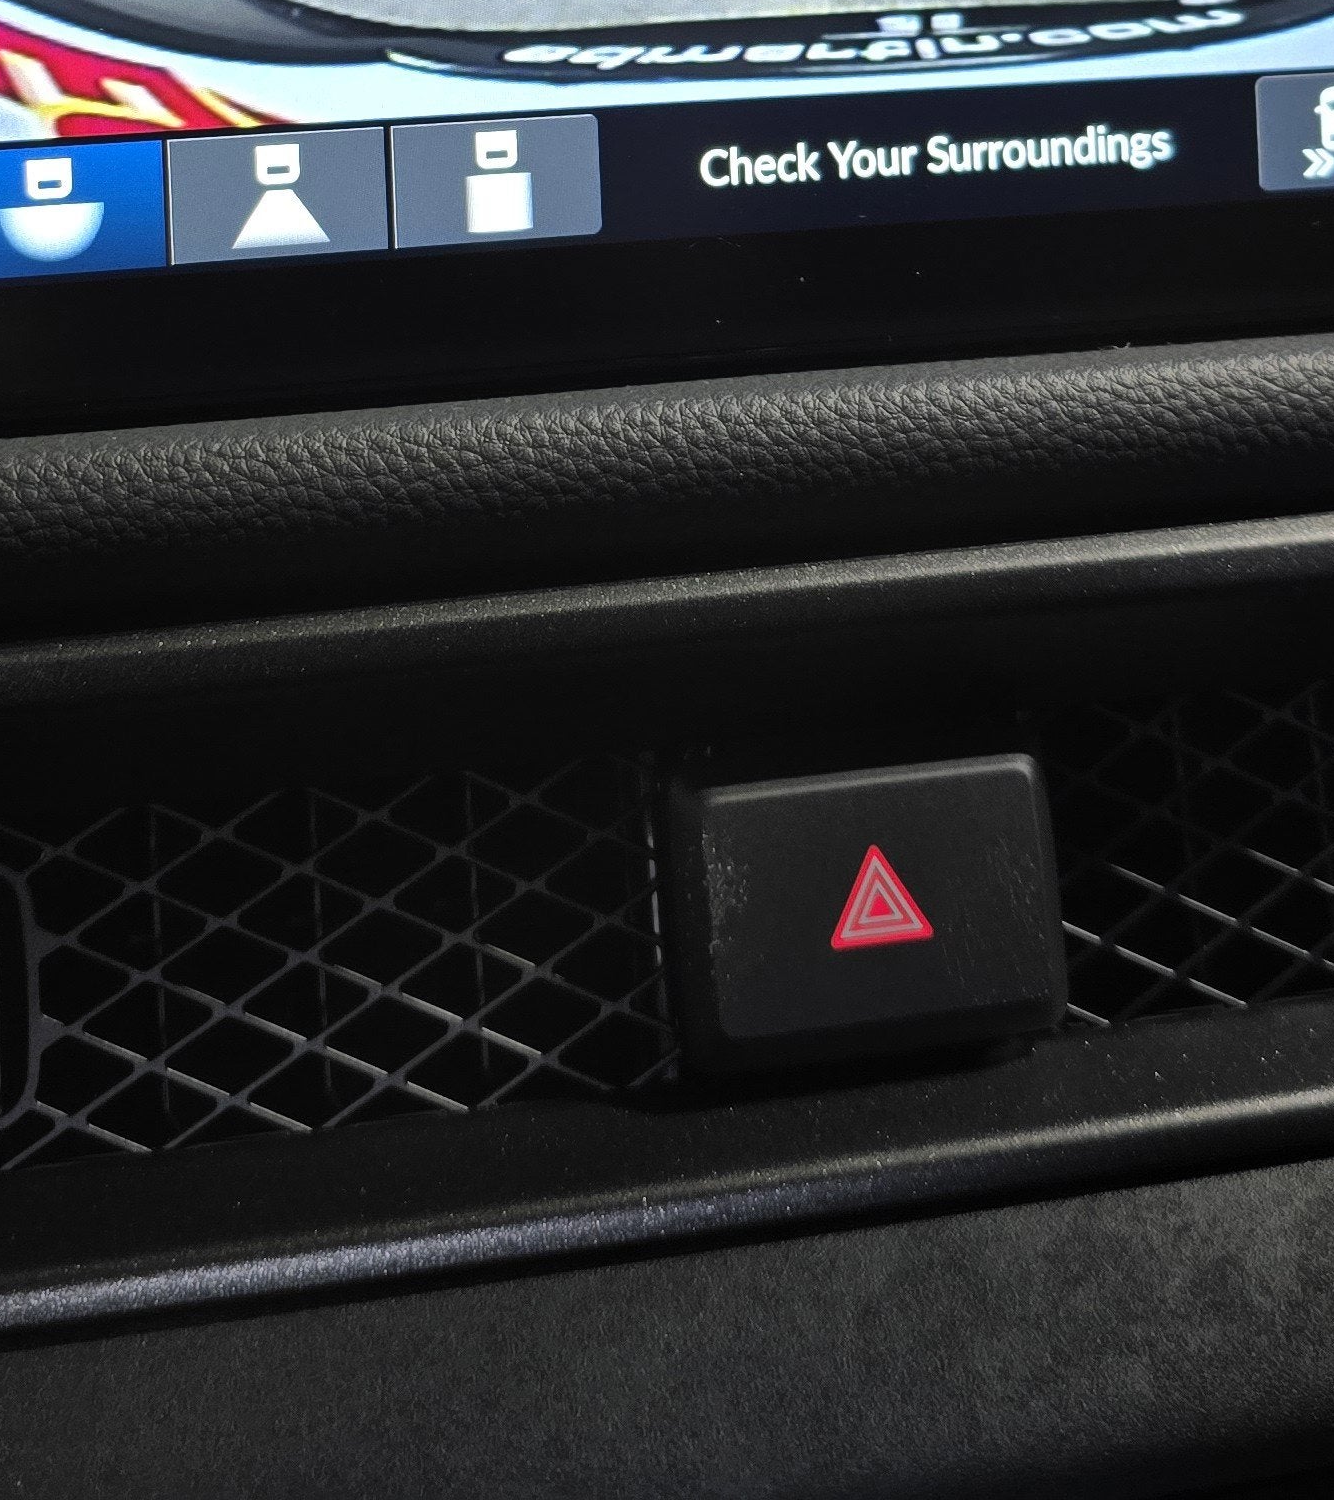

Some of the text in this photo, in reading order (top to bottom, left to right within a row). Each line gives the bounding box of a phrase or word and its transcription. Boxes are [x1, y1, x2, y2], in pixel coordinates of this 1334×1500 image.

[700, 125, 1173, 186] Check Your Surroundings
